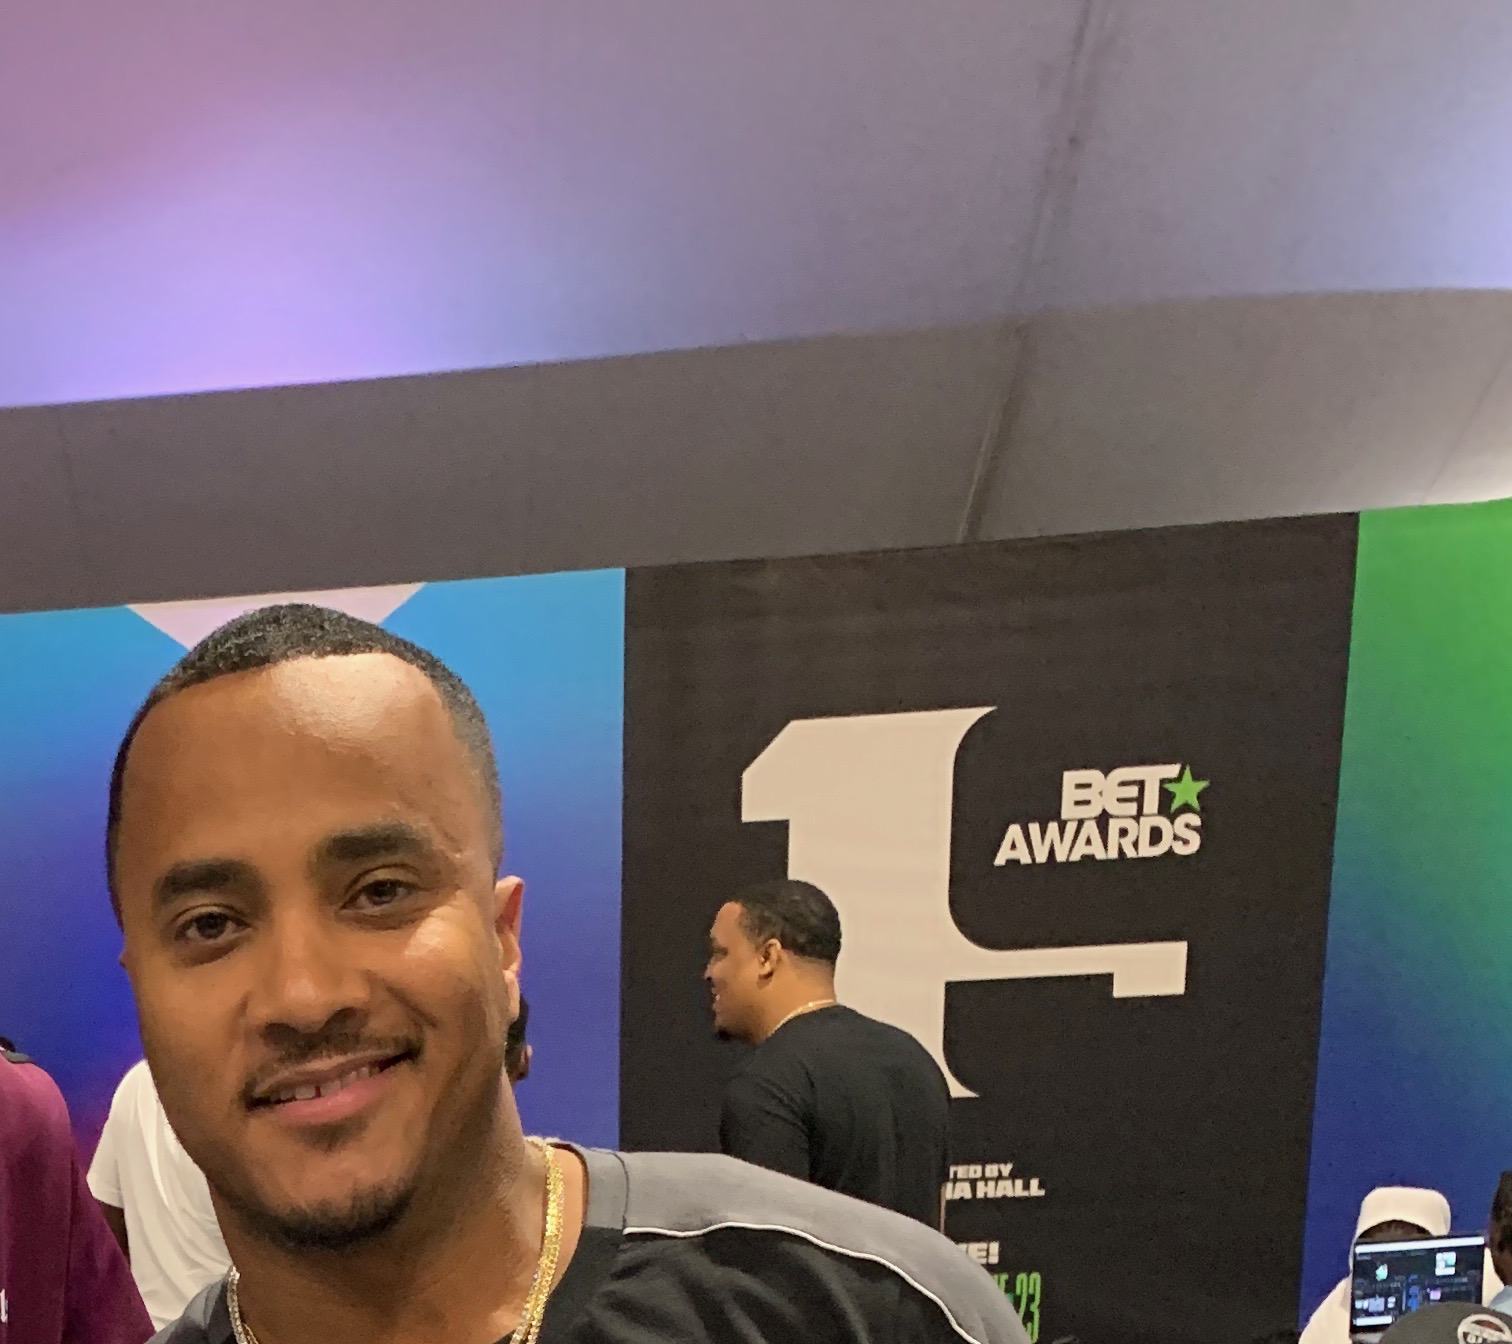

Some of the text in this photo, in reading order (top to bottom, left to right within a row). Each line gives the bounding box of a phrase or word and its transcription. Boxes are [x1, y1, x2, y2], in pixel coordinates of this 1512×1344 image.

[1061, 763, 1181, 820] BET
[993, 813, 1201, 867] AWARDS
[976, 1178, 1046, 1200] HALL
[985, 1162, 1014, 1178] BY
